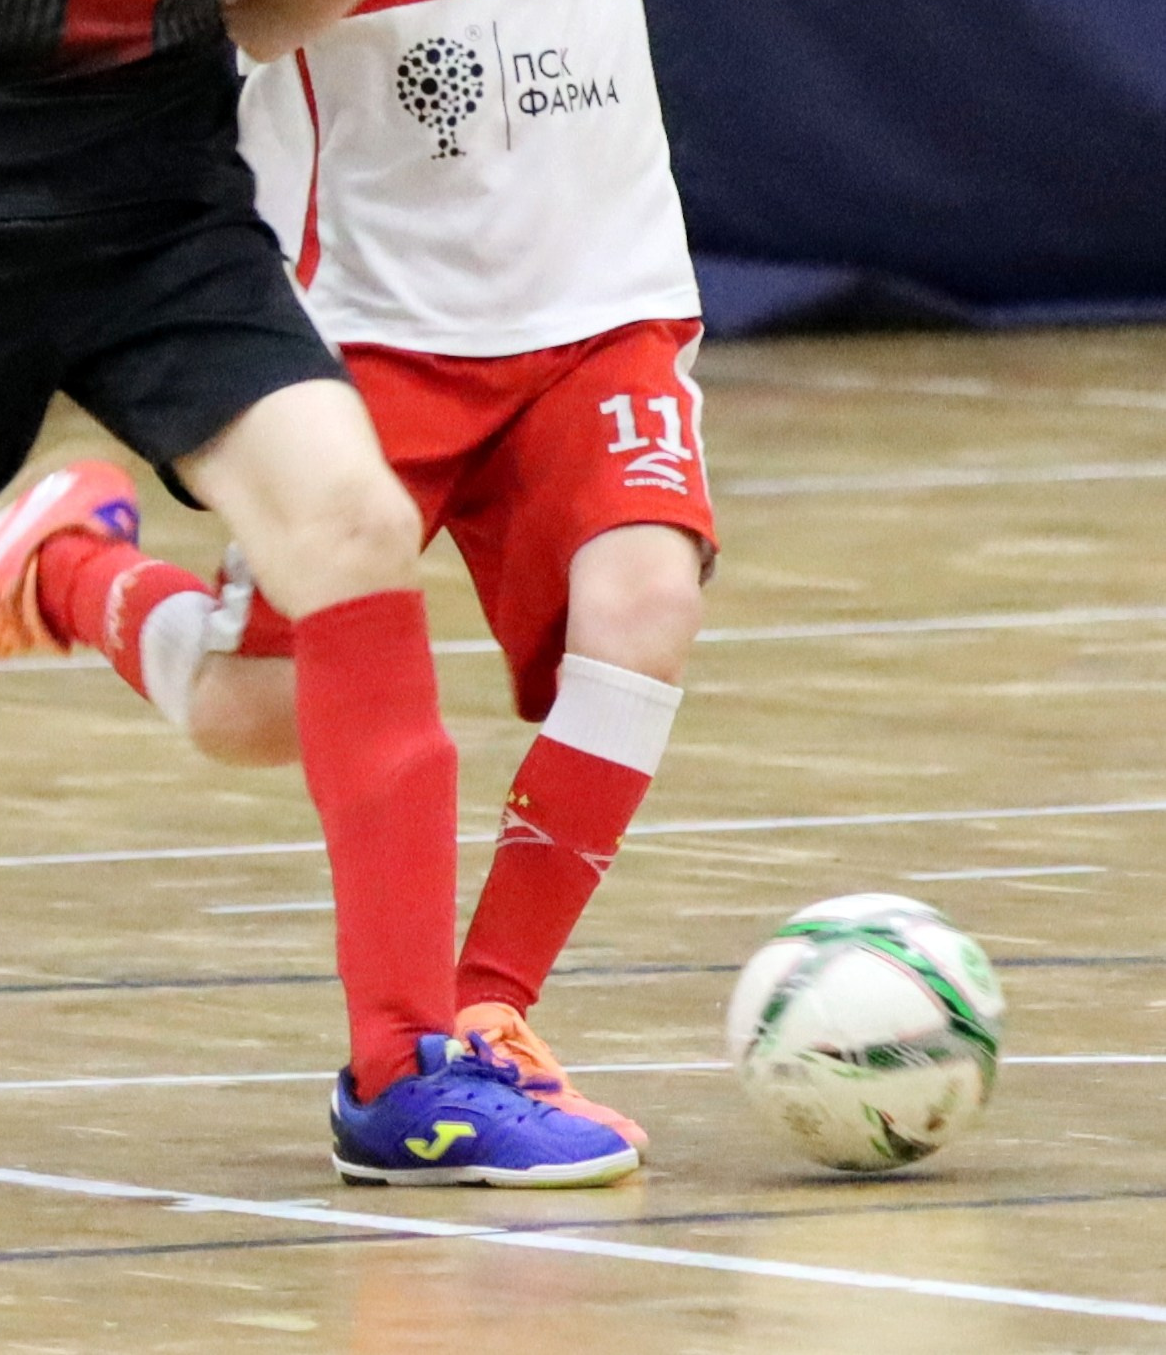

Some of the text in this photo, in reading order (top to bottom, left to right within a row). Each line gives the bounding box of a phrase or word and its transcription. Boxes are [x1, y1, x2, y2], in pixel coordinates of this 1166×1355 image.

[513, 47, 571, 83] ПСК
[518, 75, 619, 117] ФАРМА
[599, 394, 693, 460] 11
